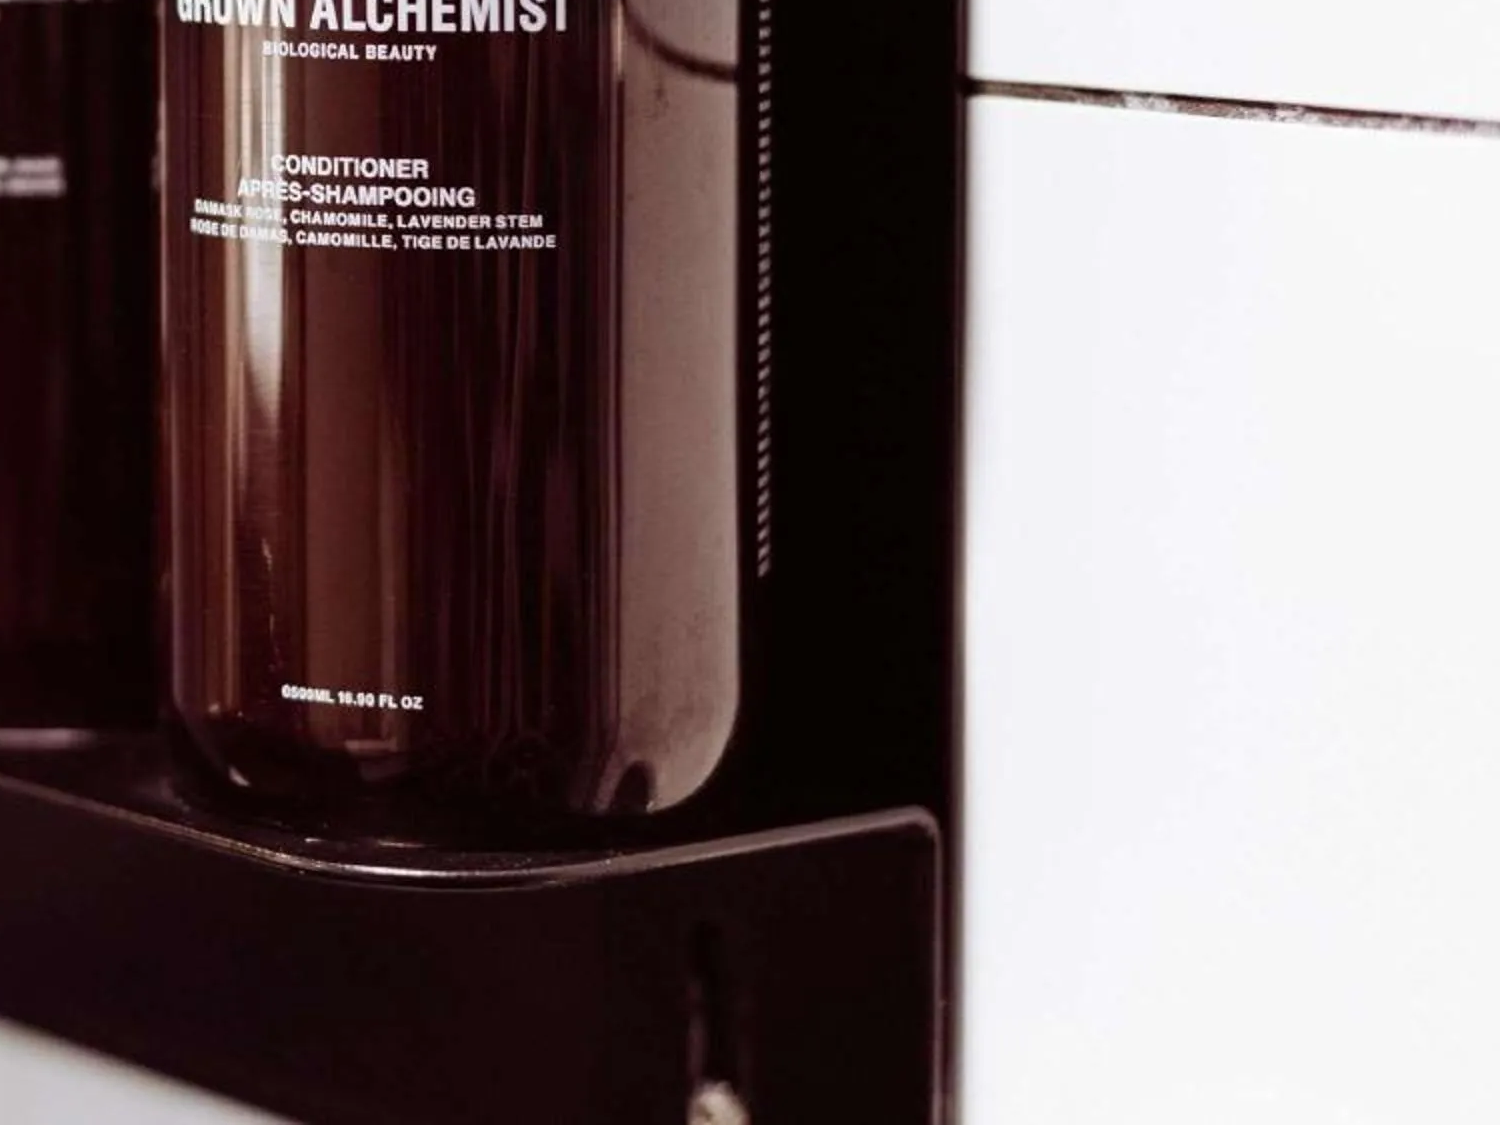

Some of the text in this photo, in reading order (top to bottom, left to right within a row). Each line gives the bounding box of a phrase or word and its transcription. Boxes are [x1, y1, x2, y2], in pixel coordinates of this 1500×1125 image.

[262, 41, 437, 61] BIOLOGICAL BEAUTY
[271, 154, 429, 179] CONDITIONER
[237, 174, 476, 207] APRÈS-SHAMPOOING
[290, 209, 393, 230] CHAMOMILE,
[397, 215, 491, 229] LAVENDER
[495, 215, 543, 229] STEM
[220, 222, 238, 237] DE
[296, 230, 397, 250] CAMOMILLE,
[402, 235, 443, 249] TIGE
[446, 235, 470, 249] DE
[474, 234, 556, 249] LAVANDE
[379, 694, 398, 709] FL
[401, 696, 424, 710] OZ
